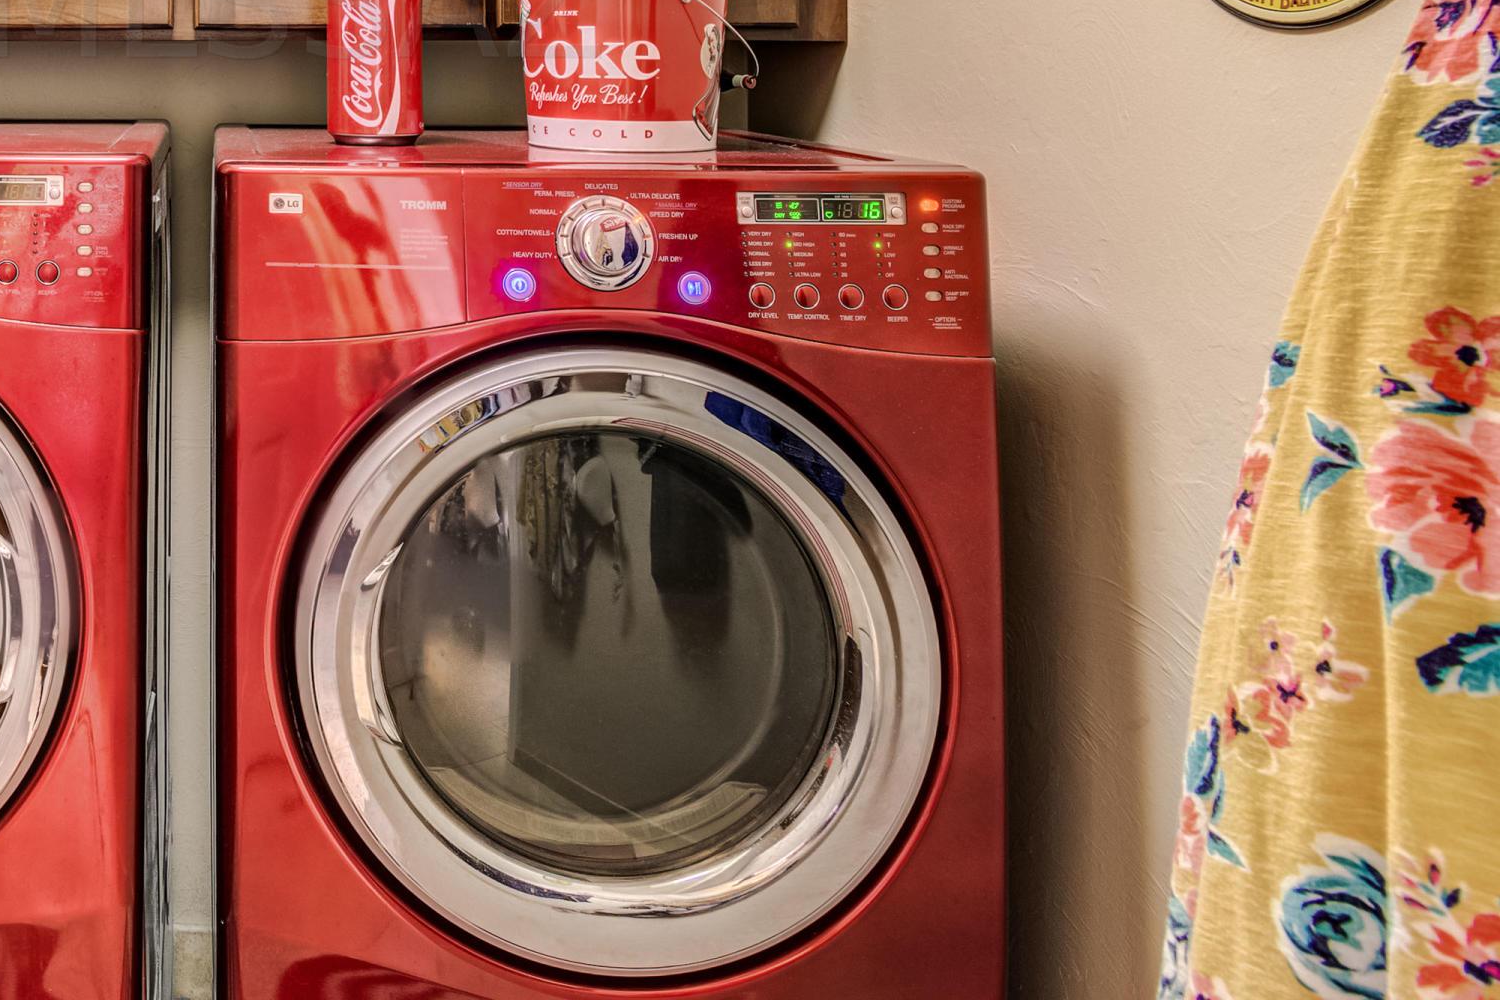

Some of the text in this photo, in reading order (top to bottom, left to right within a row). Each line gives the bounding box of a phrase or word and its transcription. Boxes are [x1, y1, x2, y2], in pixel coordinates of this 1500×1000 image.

[529, 82, 568, 110] Refreshes
[571, 84, 597, 110] You
[286, 199, 299, 208] LG
[399, 200, 447, 210] TROMM
[863, 202, 880, 219] 16
[804, 313, 830, 321] CONTROL
